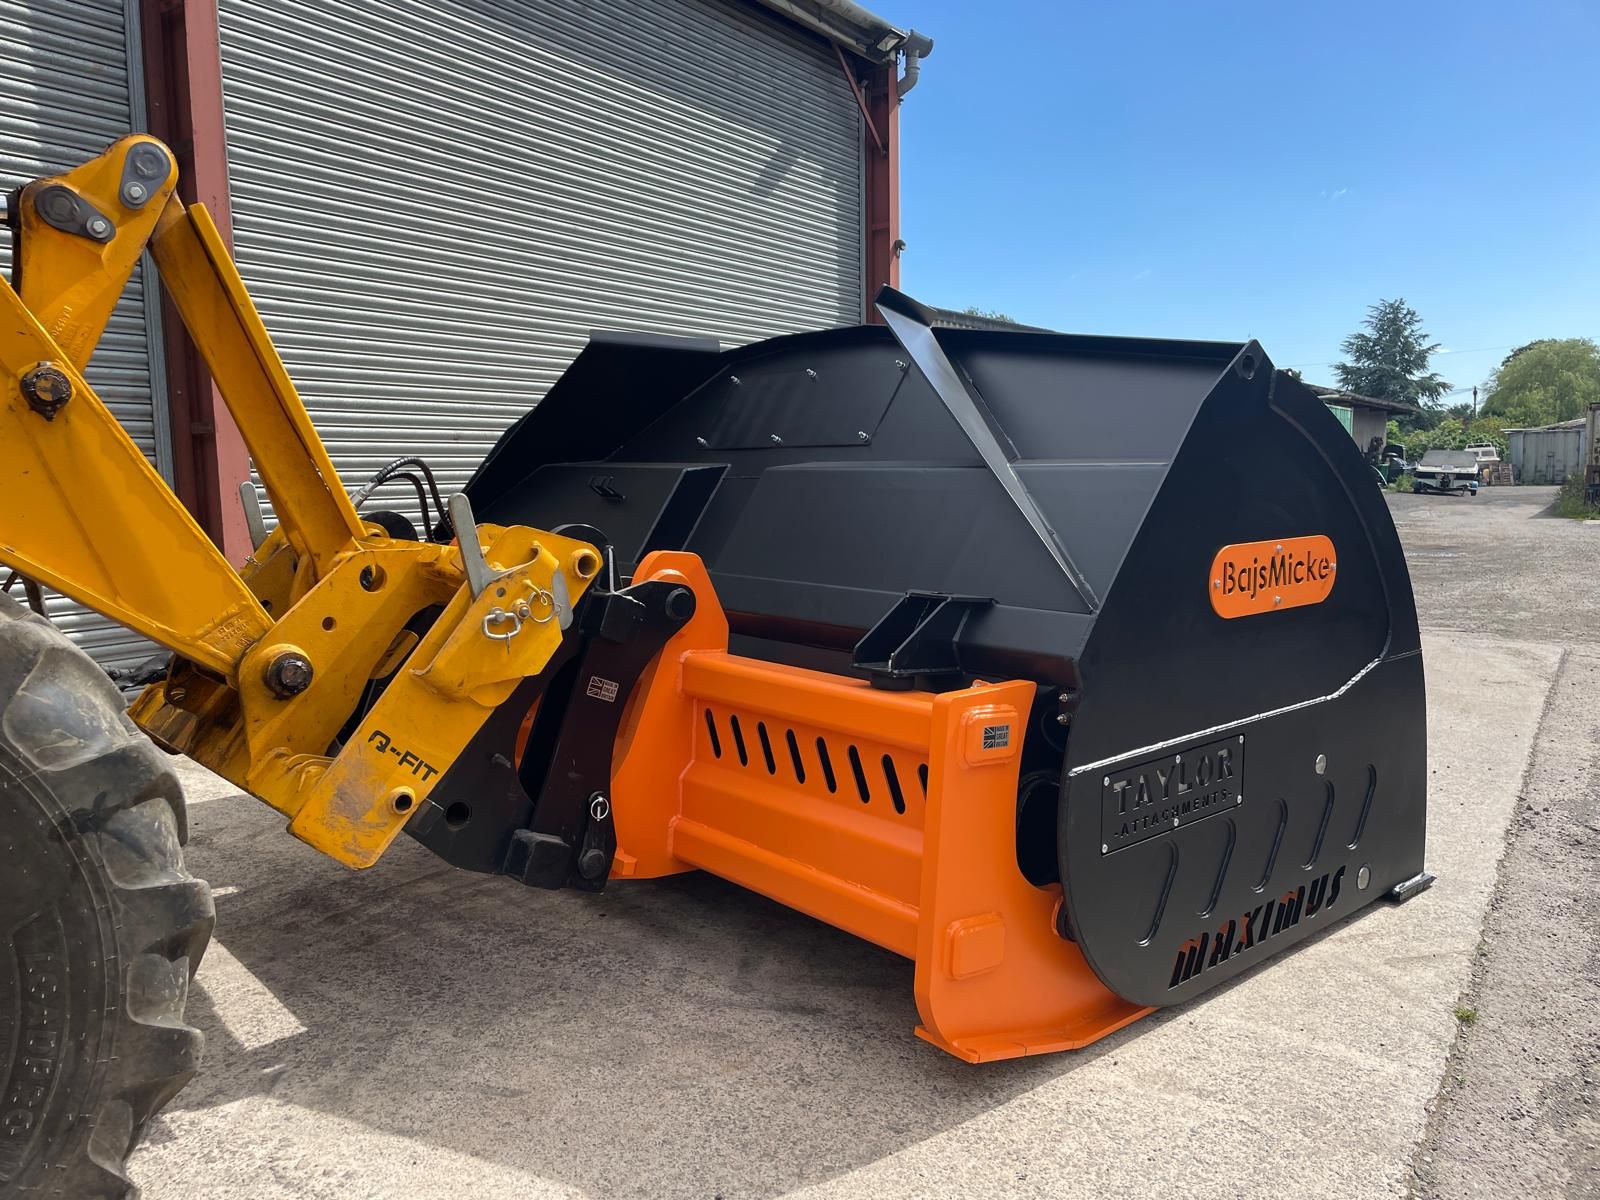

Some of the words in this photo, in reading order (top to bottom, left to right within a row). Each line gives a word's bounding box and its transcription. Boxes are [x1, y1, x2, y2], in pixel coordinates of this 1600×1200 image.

[1222, 550, 1330, 600] BajsMicke
[367, 730, 439, 782] Q-FIT
[1113, 748, 1232, 815] TAYLOR
[1167, 865, 1346, 991] MAXIMUS
